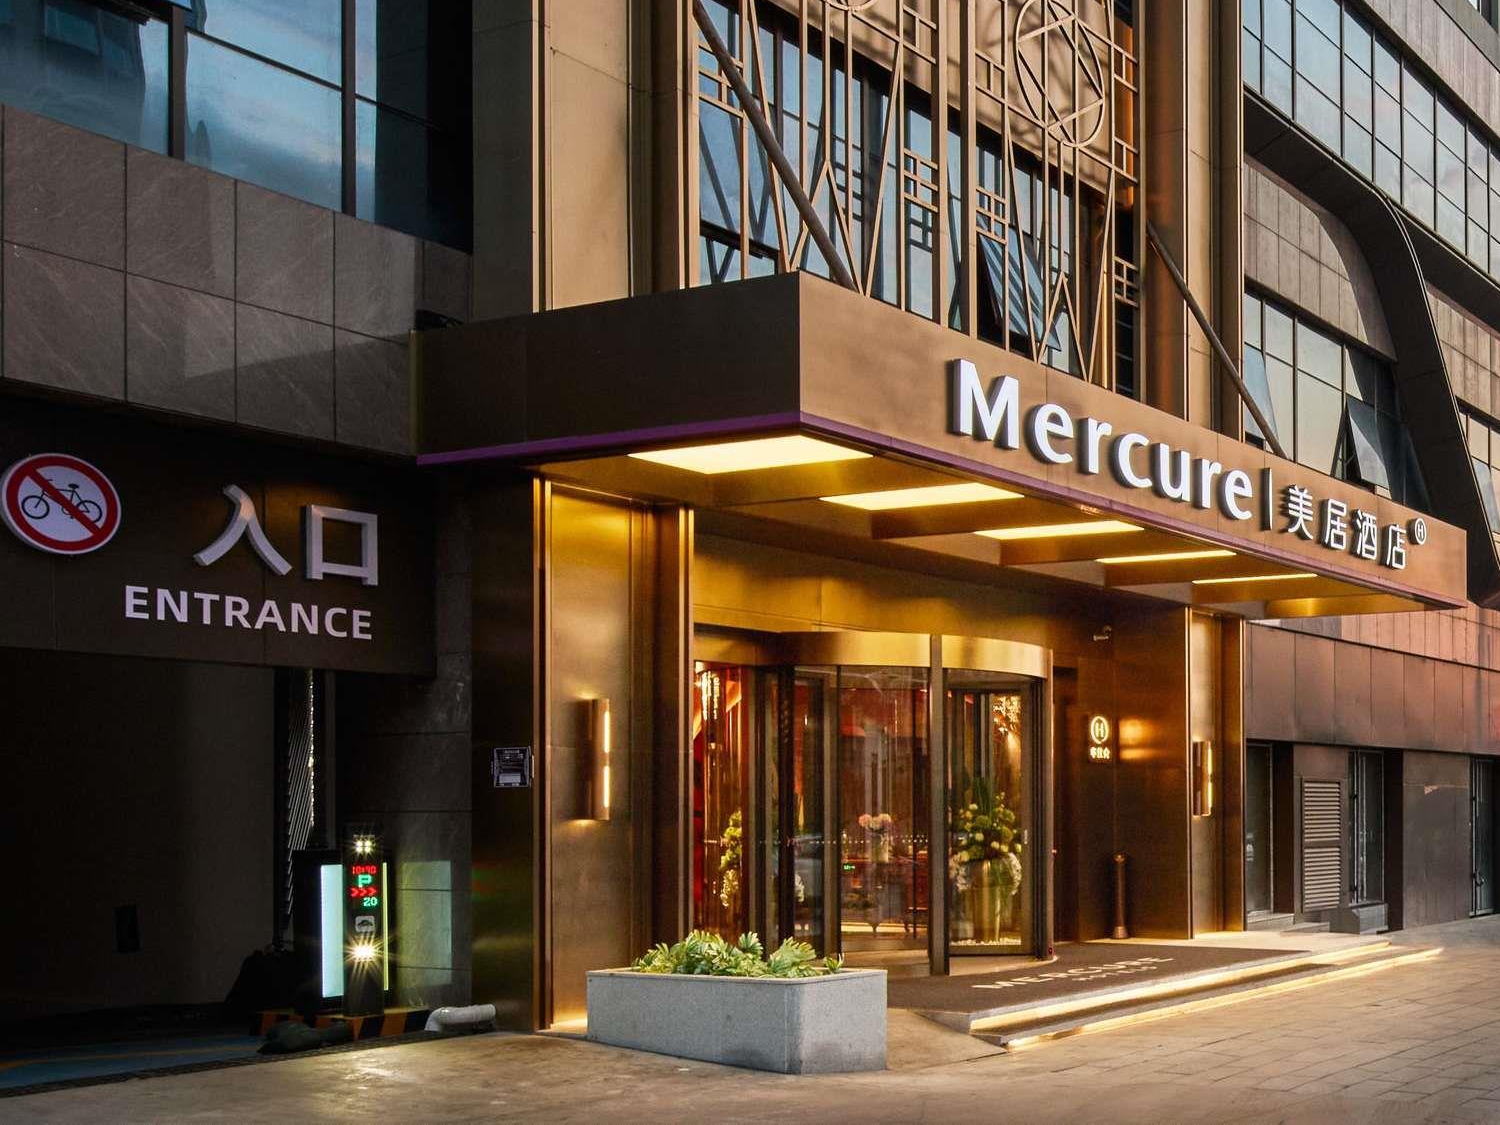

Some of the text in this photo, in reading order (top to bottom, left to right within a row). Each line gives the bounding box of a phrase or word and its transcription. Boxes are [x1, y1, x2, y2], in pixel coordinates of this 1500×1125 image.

[953, 358, 1253, 521] Mercure
[193, 484, 379, 586] 入口
[1286, 485, 1407, 570] 美居酒店
[125, 585, 373, 640] ENTRANCE
[358, 874, 373, 887] P
[363, 896, 378, 907] 20
[971, 957, 1175, 989] MERCURE
